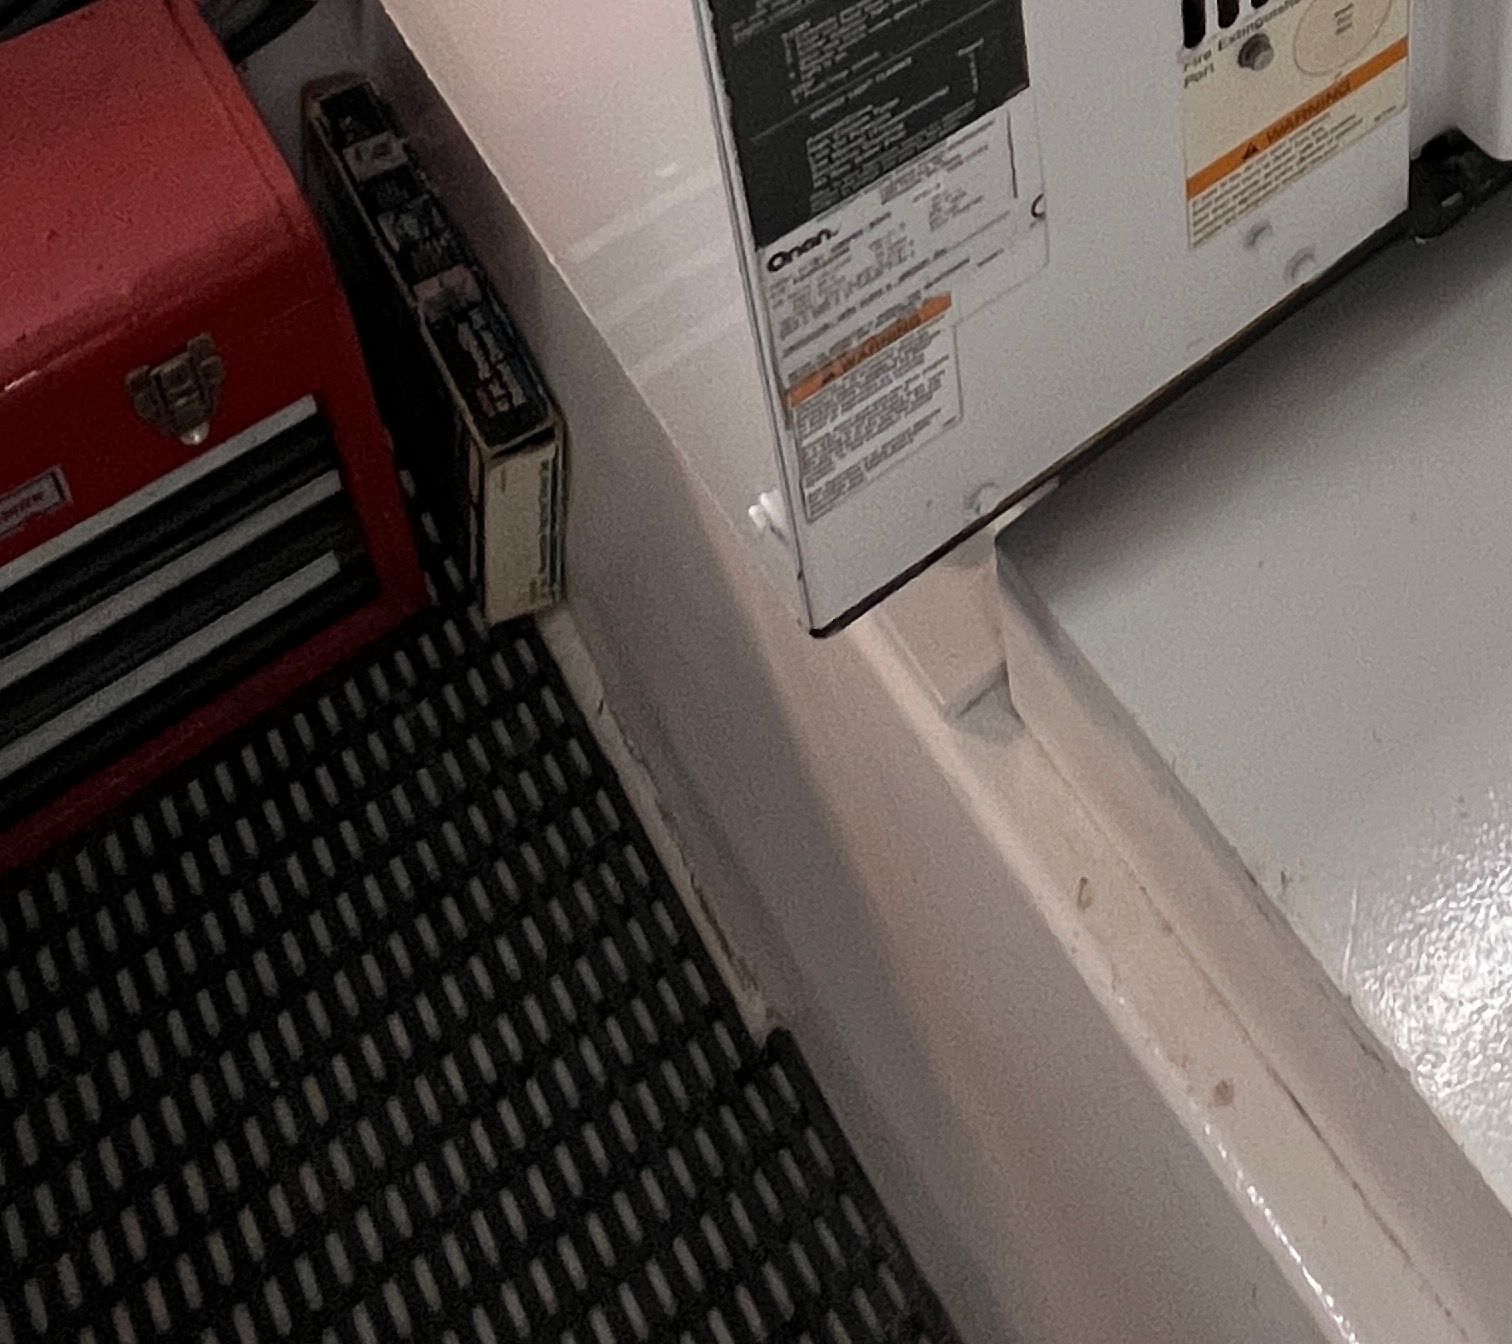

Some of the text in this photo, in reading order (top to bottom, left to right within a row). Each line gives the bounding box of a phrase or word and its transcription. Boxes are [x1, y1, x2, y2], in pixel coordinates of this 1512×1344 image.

[1183, 48, 1212, 73] Fire
[1184, 62, 1215, 89] Port
[1266, 79, 1351, 143] WARNING
[766, 227, 834, 274] Onan
